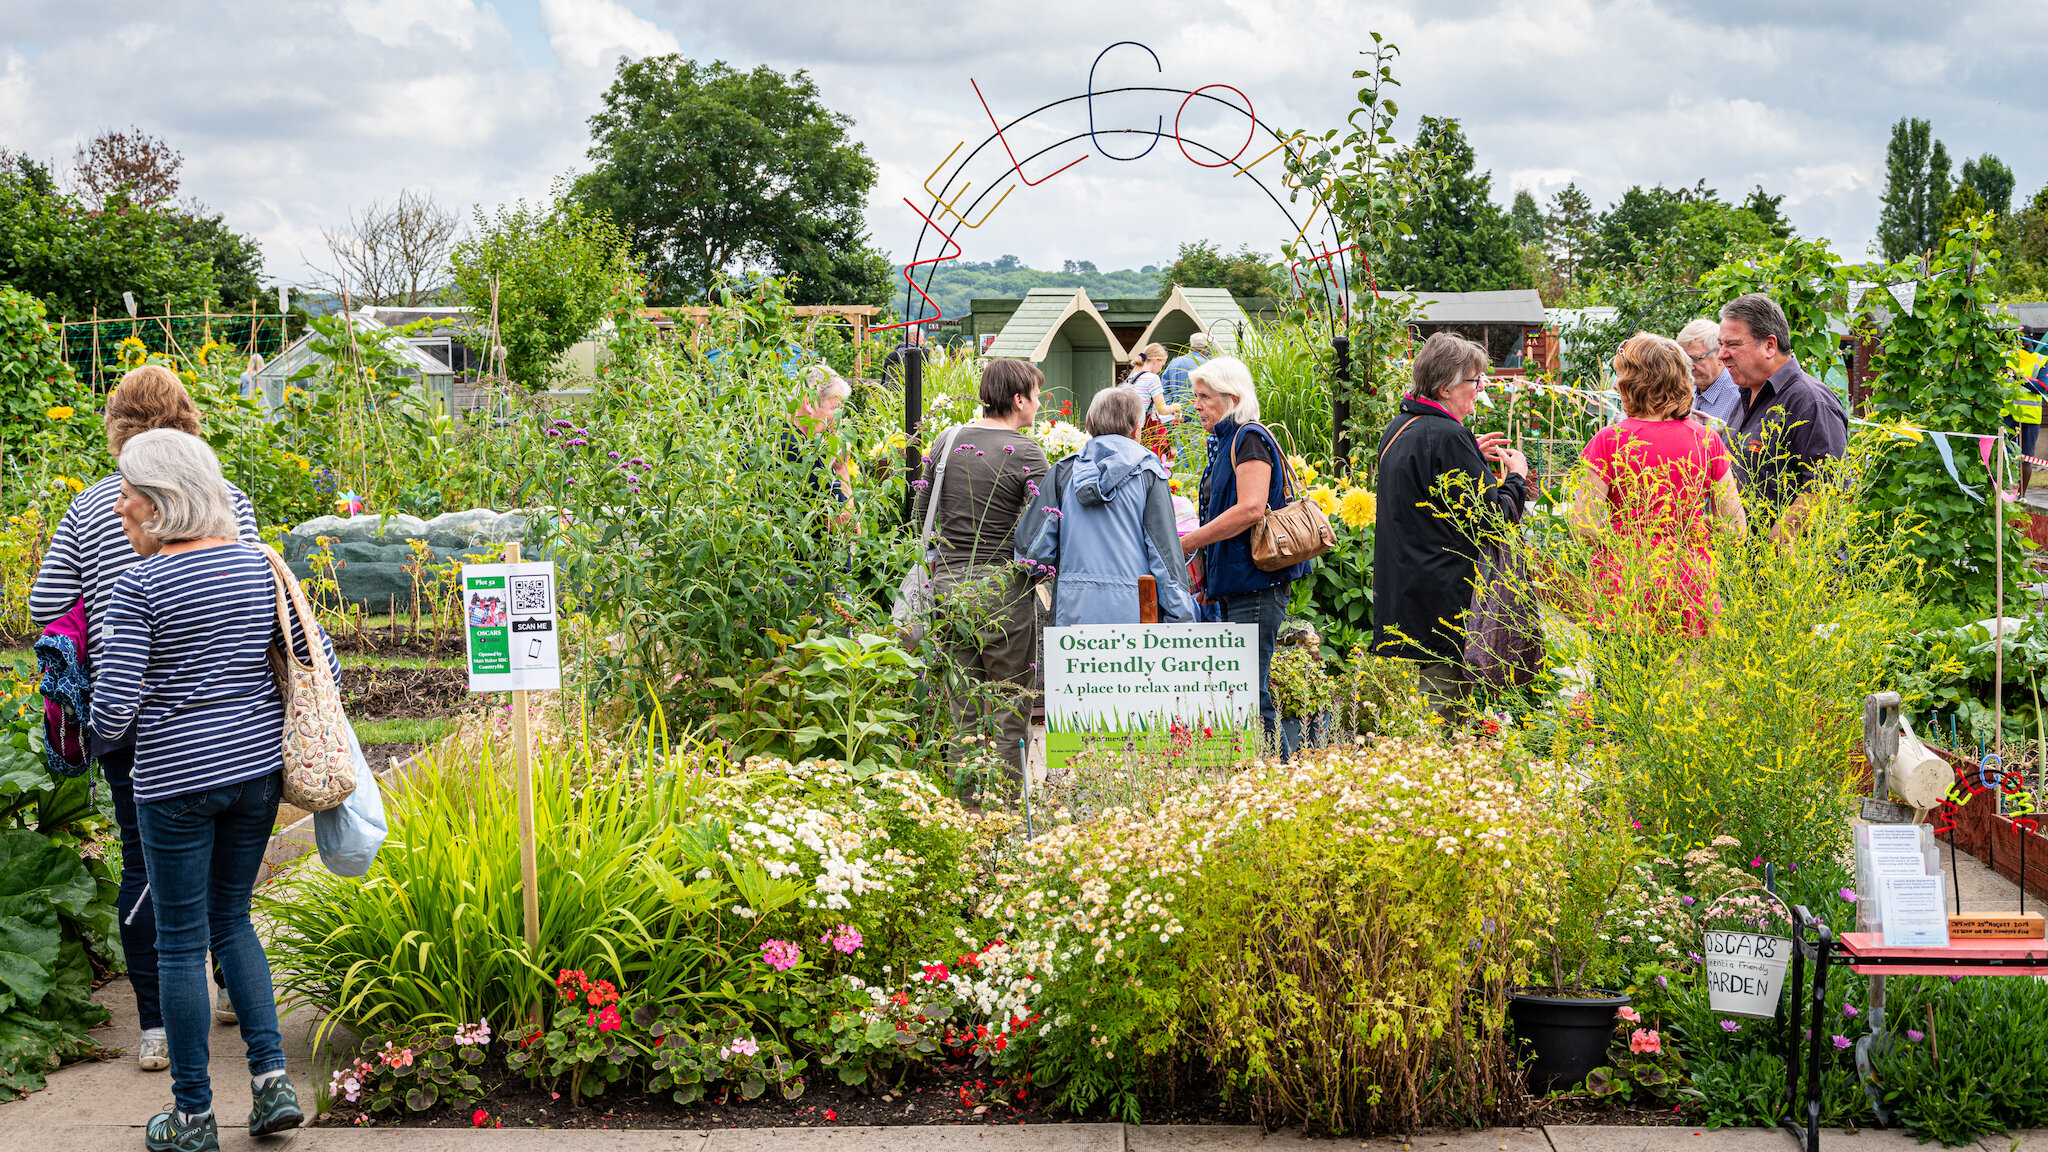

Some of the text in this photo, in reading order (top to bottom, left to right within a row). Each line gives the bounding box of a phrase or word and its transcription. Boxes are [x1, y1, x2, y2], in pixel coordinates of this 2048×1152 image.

[517, 622, 547, 631] SCAN ME
[1059, 631, 1246, 651] Oscar's Dementia
[1066, 655, 1240, 676] Friendly Garden
[1063, 683, 1073, 694] A
[1077, 682, 1114, 697] place
[1118, 683, 1131, 693] to
[1135, 681, 1170, 693] relax
[1174, 682, 1200, 692] and
[1204, 680, 1249, 693] reflect
[1933, 754, 2038, 835] WELCOME
[1705, 933, 1777, 958] OSCARS
[1738, 961, 1769, 976] Friendly
